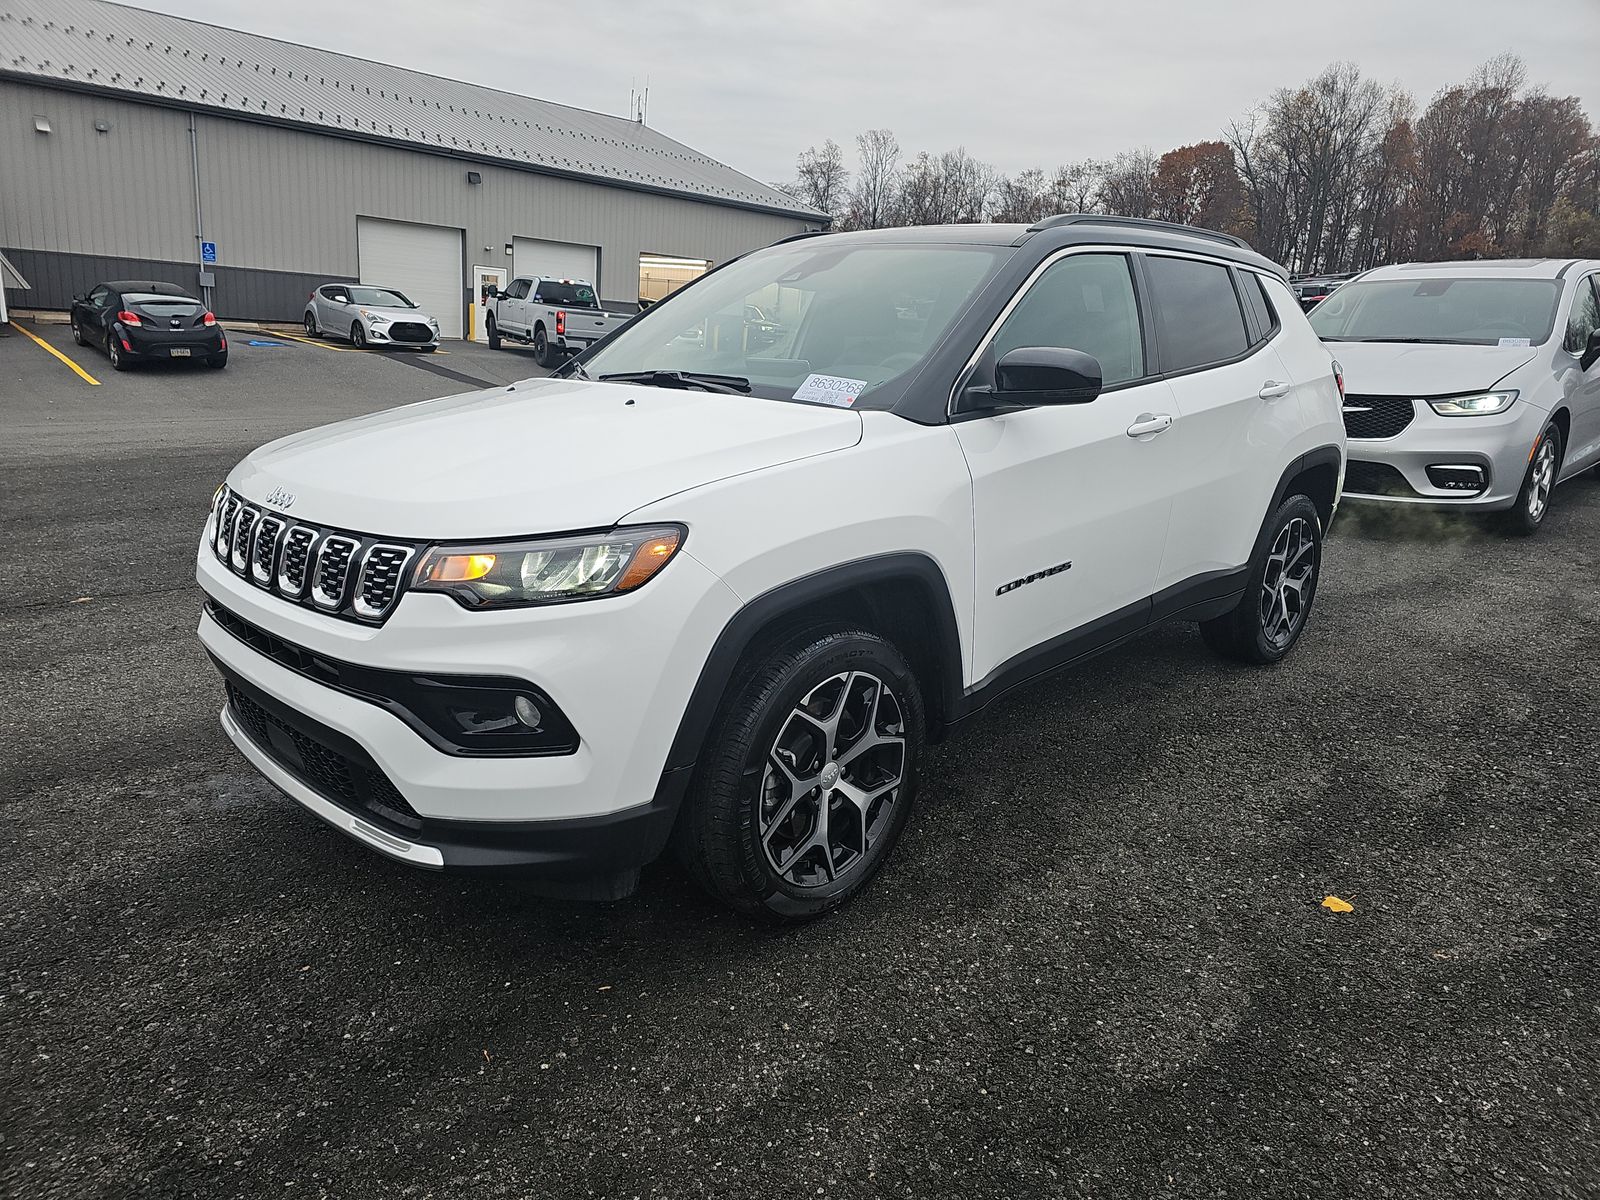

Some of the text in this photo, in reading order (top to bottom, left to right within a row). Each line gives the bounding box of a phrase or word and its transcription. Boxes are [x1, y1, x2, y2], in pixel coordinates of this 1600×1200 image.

[809, 377, 865, 395] 8630268
[266, 486, 296, 511] Jeep
[995, 560, 1073, 596] COMPASS
